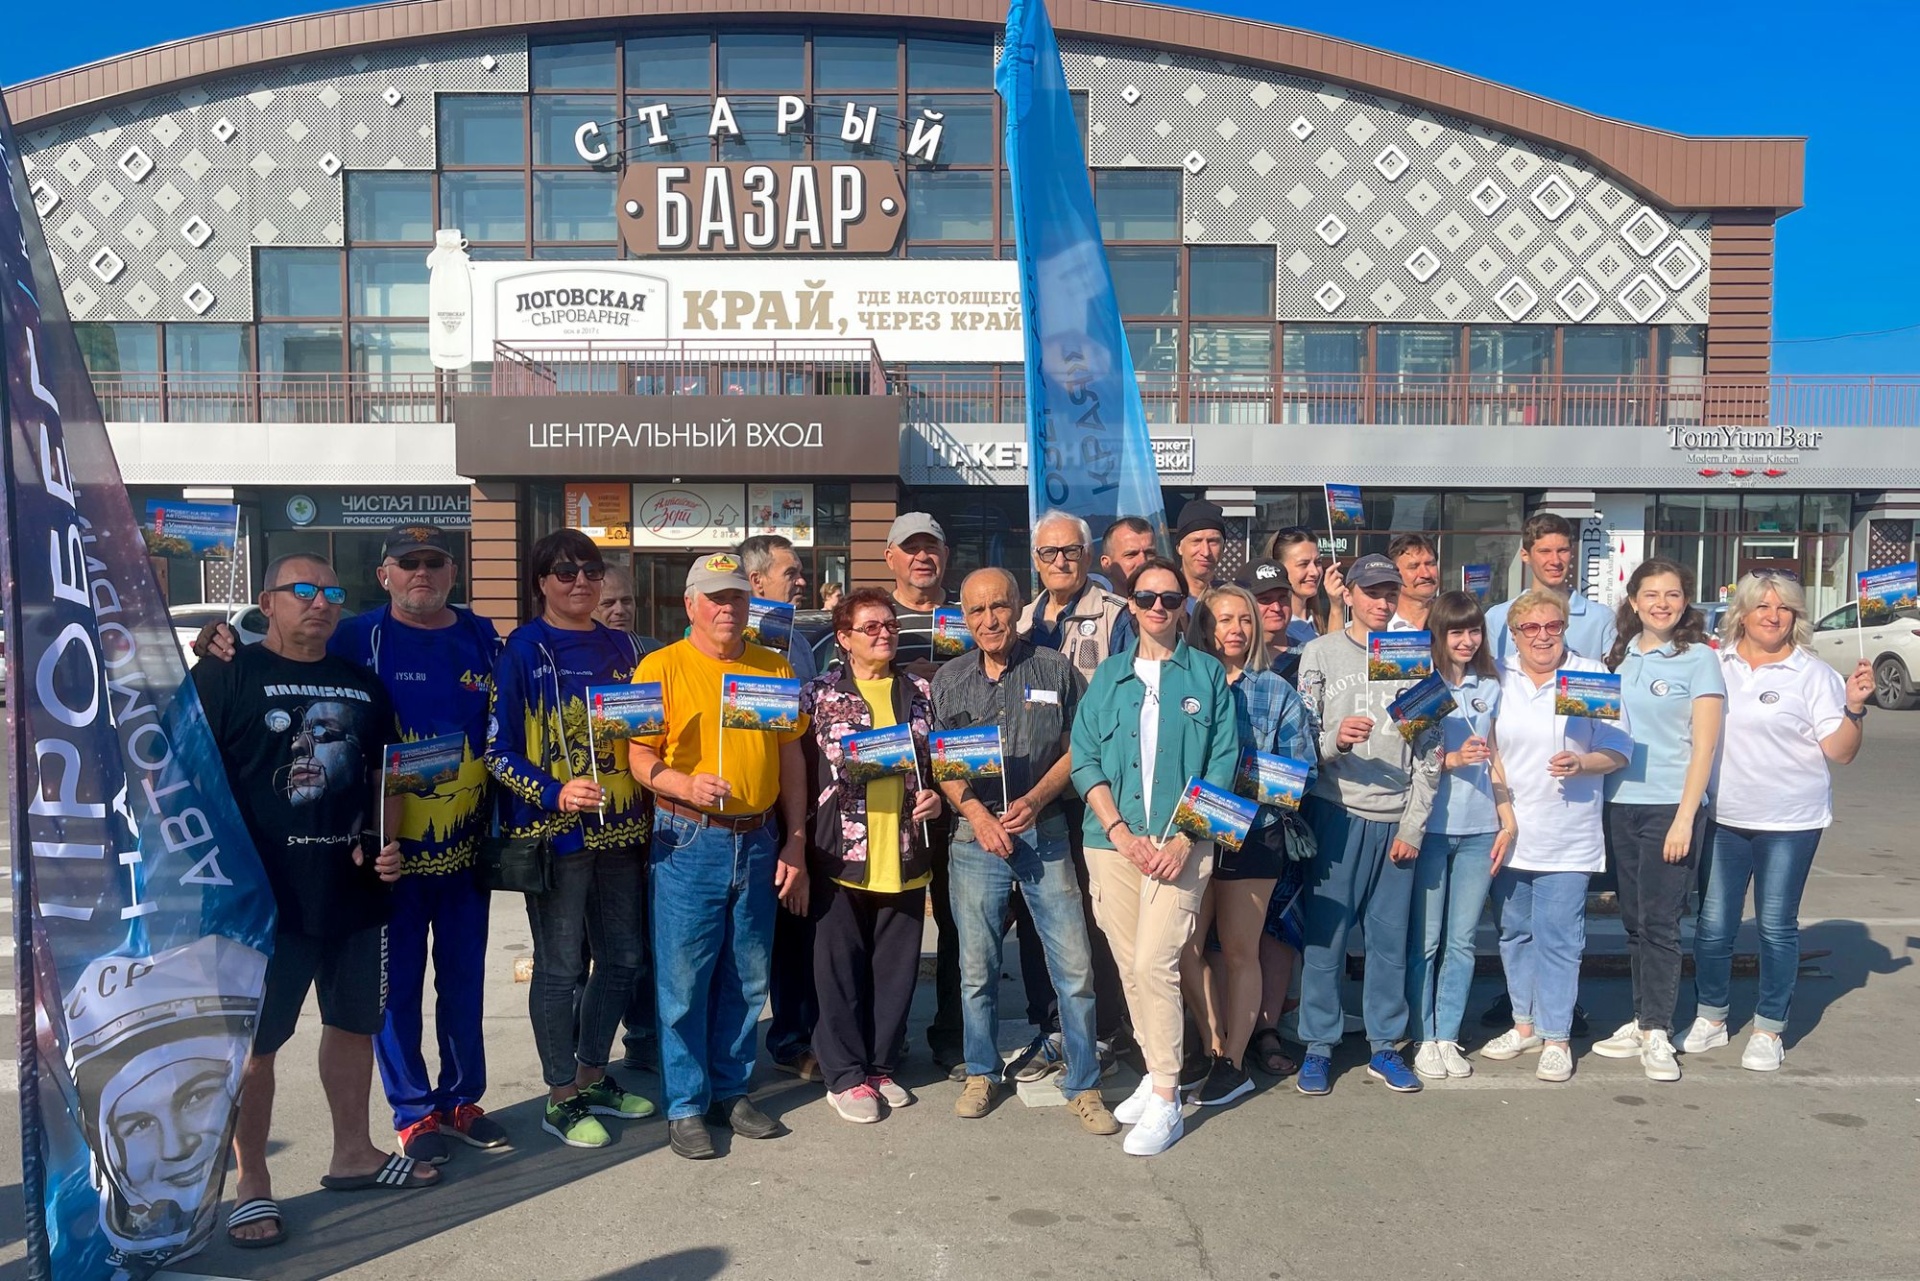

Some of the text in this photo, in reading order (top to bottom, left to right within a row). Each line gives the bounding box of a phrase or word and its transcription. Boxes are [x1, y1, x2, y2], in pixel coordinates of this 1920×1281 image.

[575, 95, 944, 165] СТАРЫЙ
[656, 165, 866, 250] БАЗАР
[516, 288, 647, 312] ЛОГОВСКАЯ
[683, 279, 847, 336] КРАЙ,
[858, 290, 1022, 306] ГДЕ НАСТОЯЩЕГО
[531, 309, 630, 327] СЫРОВАРНЯ
[858, 307, 1022, 331] ЧЕРЕЗ КРАЙ
[529, 418, 824, 448] ЦЕНТРАЛЬНЫЙ ВХОД
[1667, 425, 1823, 450] TomYumBar
[1687, 454, 1799, 463] Modern Pan Asian Kitchen
[341, 495, 471, 511] ЧИСТАЯ ПЛАН
[567, 492, 577, 528] ЗАПРАВ
[343, 516, 430, 524] ПРОФЕССИОНАЛЬНАЯ
[713, 529, 718, 538] 2
[26, 326, 106, 920] ПРОБЕГ
[395, 672, 427, 681] IYSK.RU
